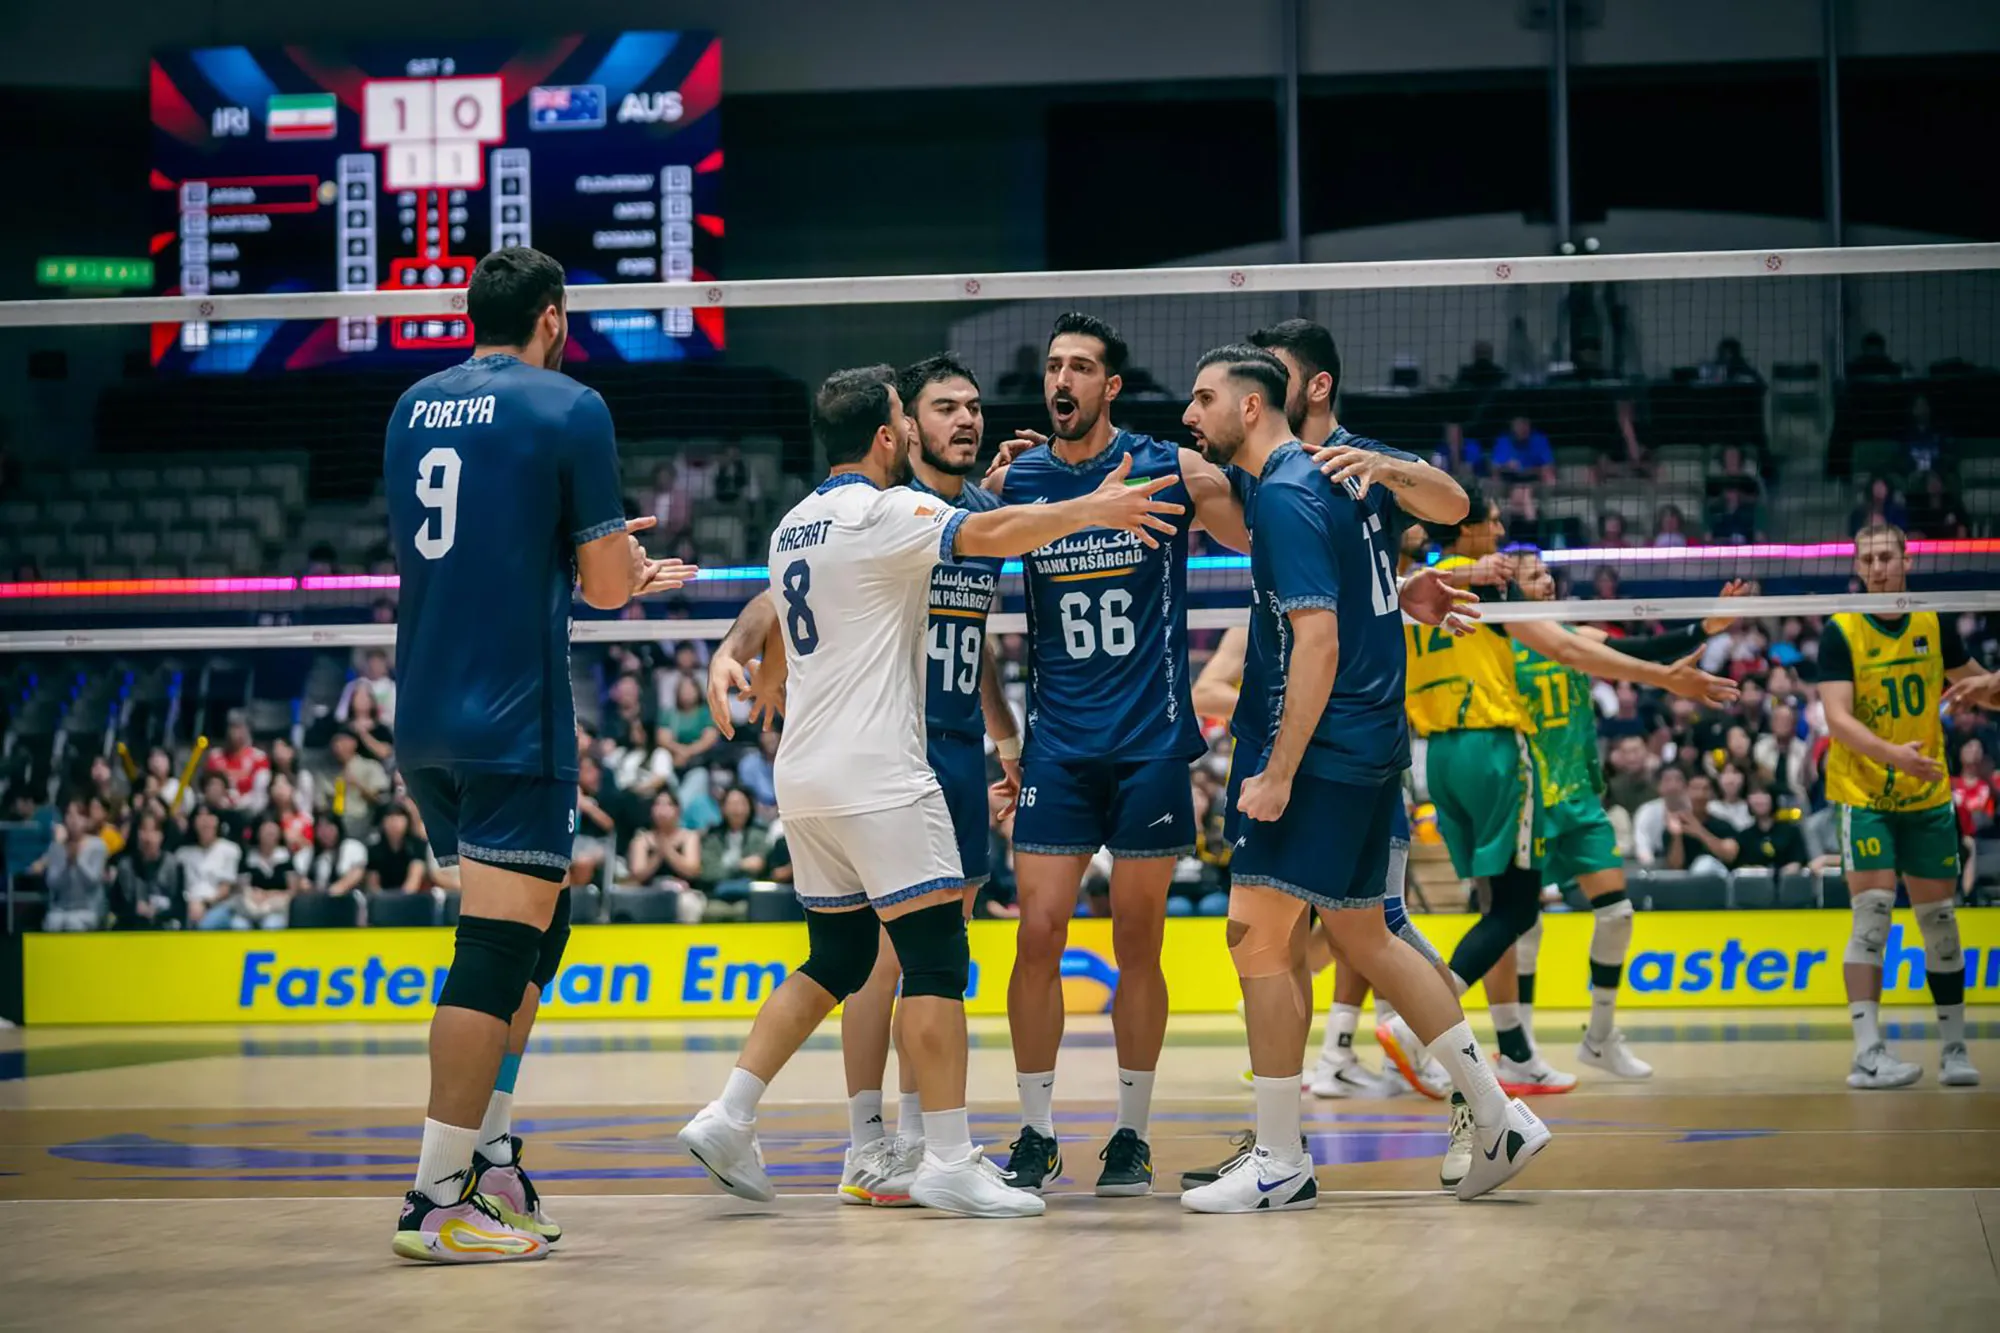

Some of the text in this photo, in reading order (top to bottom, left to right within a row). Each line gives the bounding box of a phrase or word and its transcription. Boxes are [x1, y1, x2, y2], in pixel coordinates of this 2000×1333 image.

[212, 106, 249, 137] IRI
[394, 97, 406, 132] 1
[454, 96, 481, 130] 0
[617, 91, 684, 123] AUS
[409, 395, 496, 428] PORIYA
[415, 448, 462, 559] 9
[777, 520, 832, 552] HAZRAT
[1035, 548, 1143, 574] BANK PASARGAD
[783, 559, 819, 656] 8
[1060, 589, 1135, 659] 66
[927, 623, 981, 695] 49
[1534, 673, 1569, 717] 11
[1881, 674, 1926, 718] 10
[1020, 787, 1037, 807] 66
[1856, 838, 1880, 857] 10
[1626, 939, 1827, 992] aster
